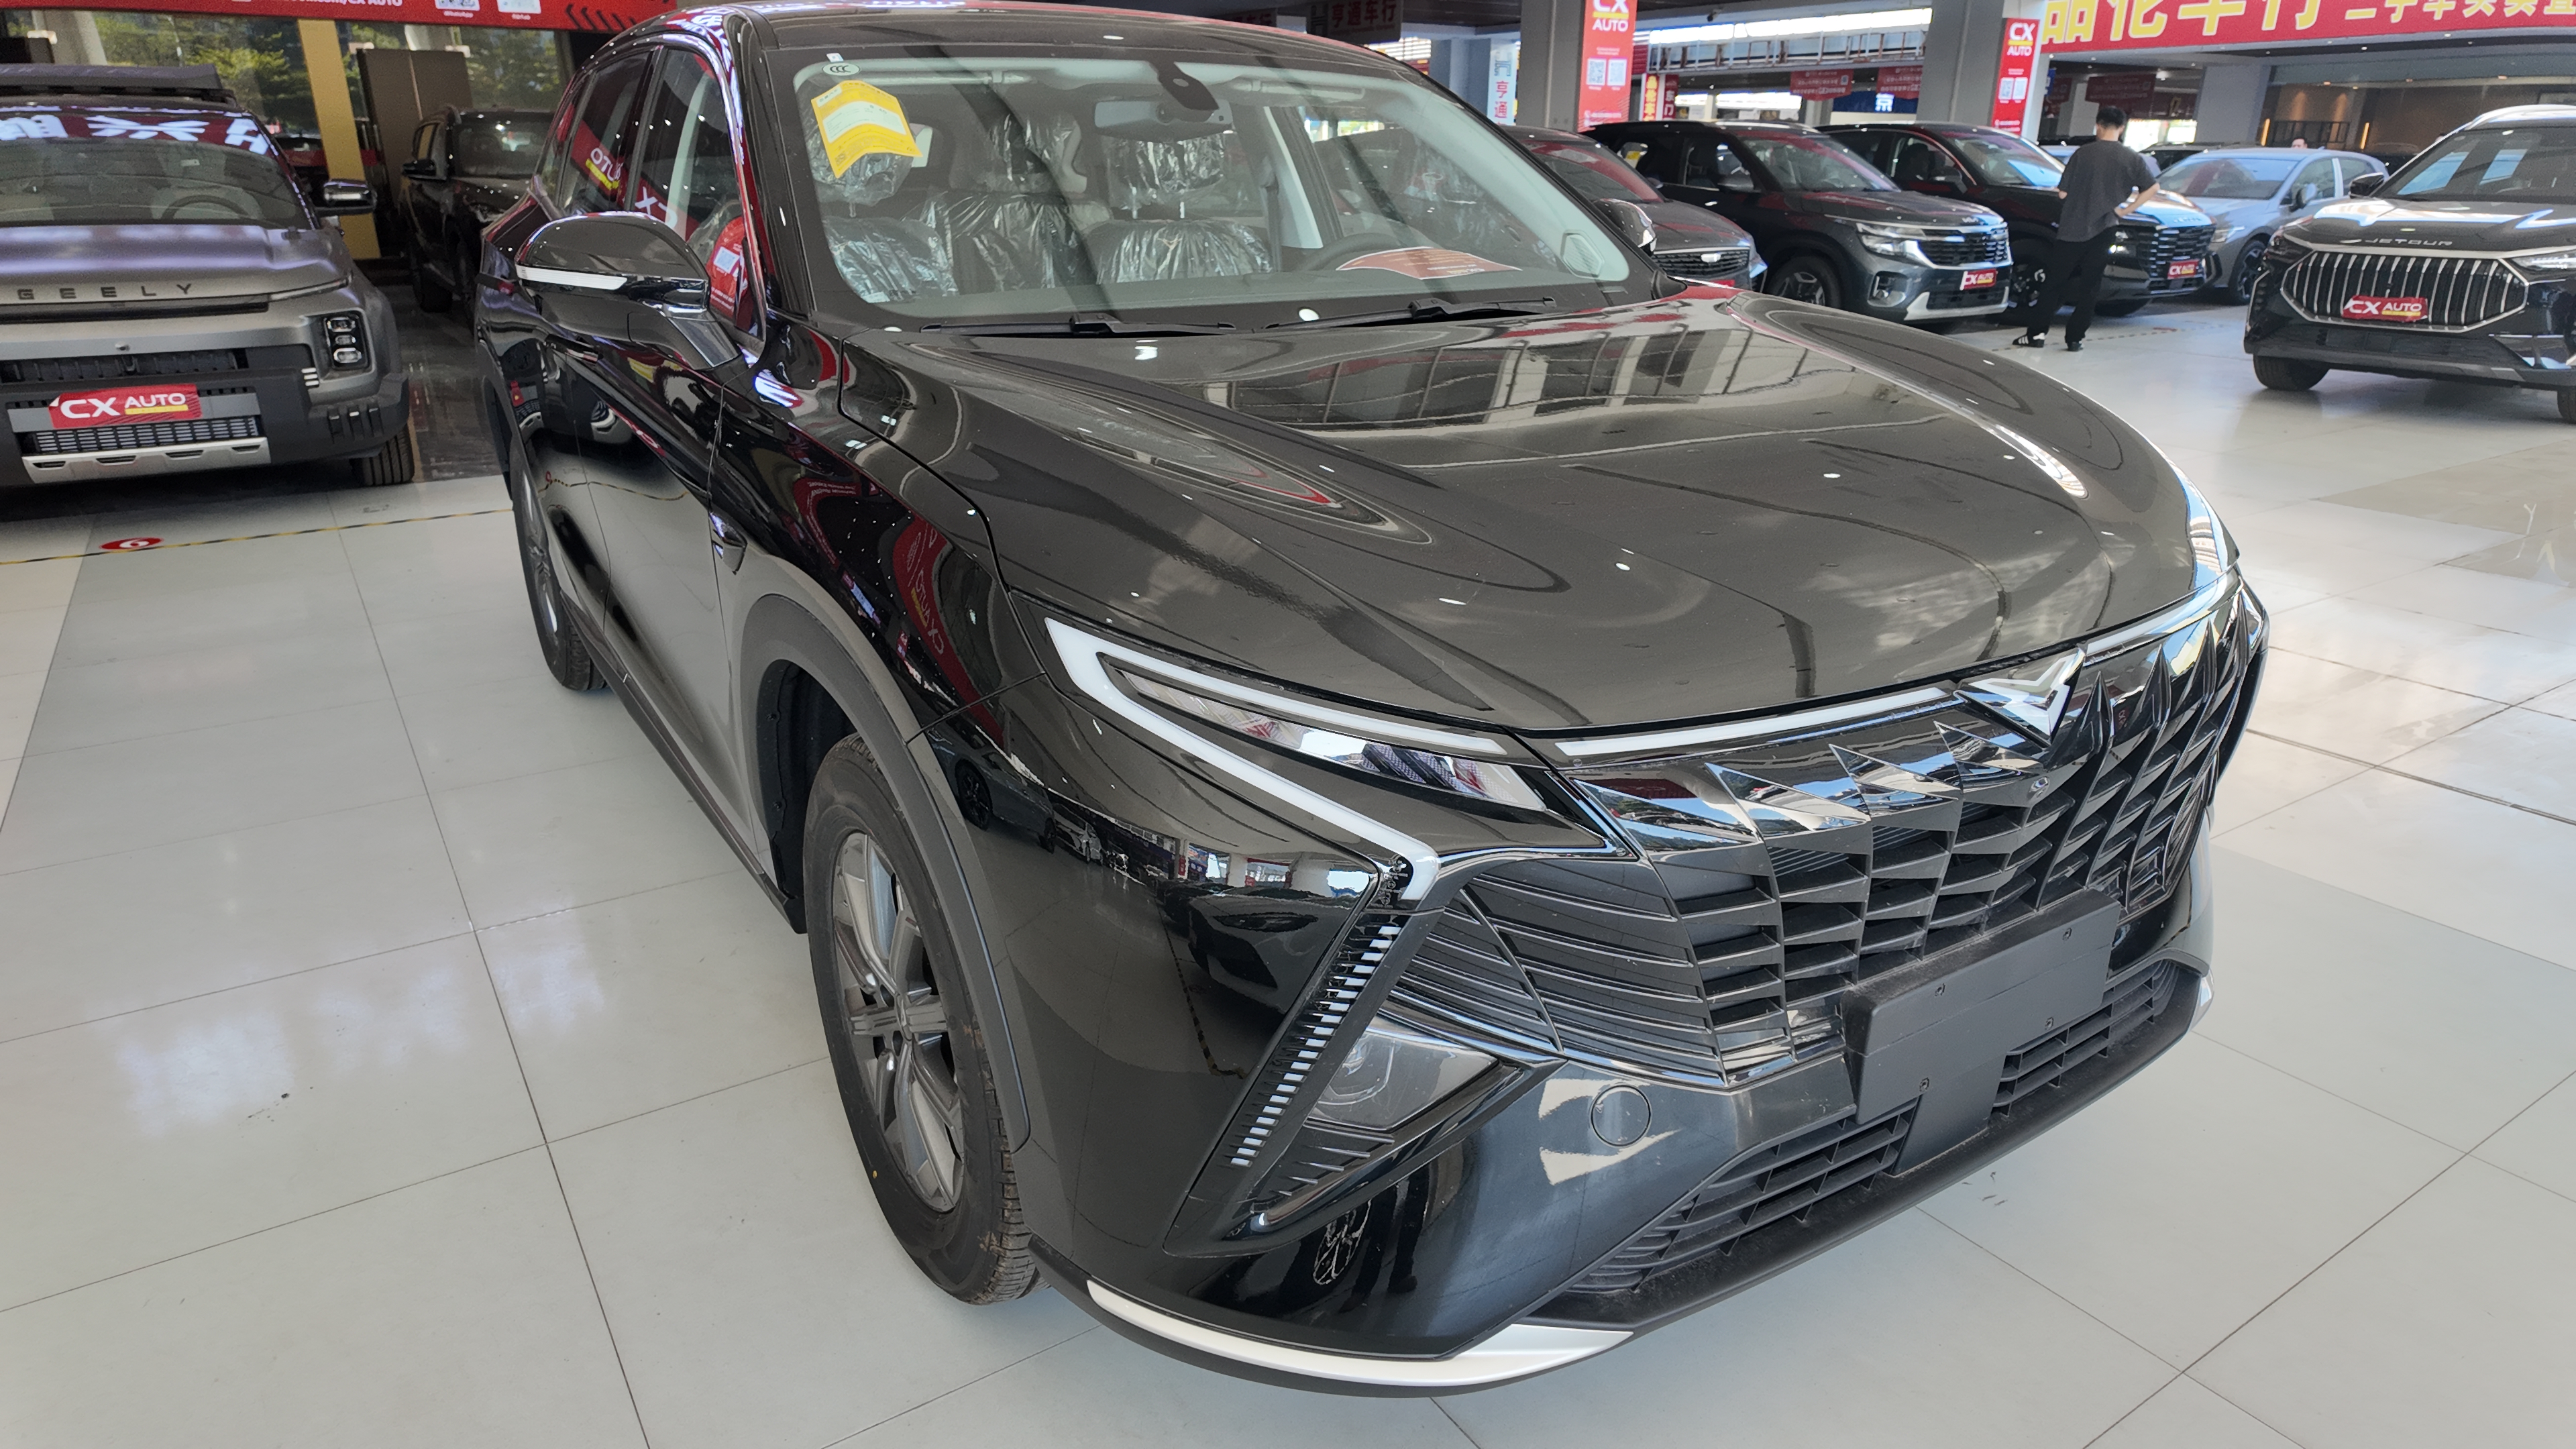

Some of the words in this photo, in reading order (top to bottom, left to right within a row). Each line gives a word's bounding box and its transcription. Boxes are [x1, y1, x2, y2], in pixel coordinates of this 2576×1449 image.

[1332, 0, 1397, 28] 亨通车行
[1592, 19, 1629, 32] AUTO
[2009, 22, 2035, 41] CX
[2007, 46, 2032, 56] AUTO
[1494, 80, 1509, 126] 亨通
[2365, 238, 2453, 246] JETOUR
[17, 284, 192, 300] GEELY
[2349, 301, 2381, 315] CX
[2383, 303, 2422, 312] AUTO
[60, 397, 121, 419] CX
[125, 393, 186, 409] AUTO
